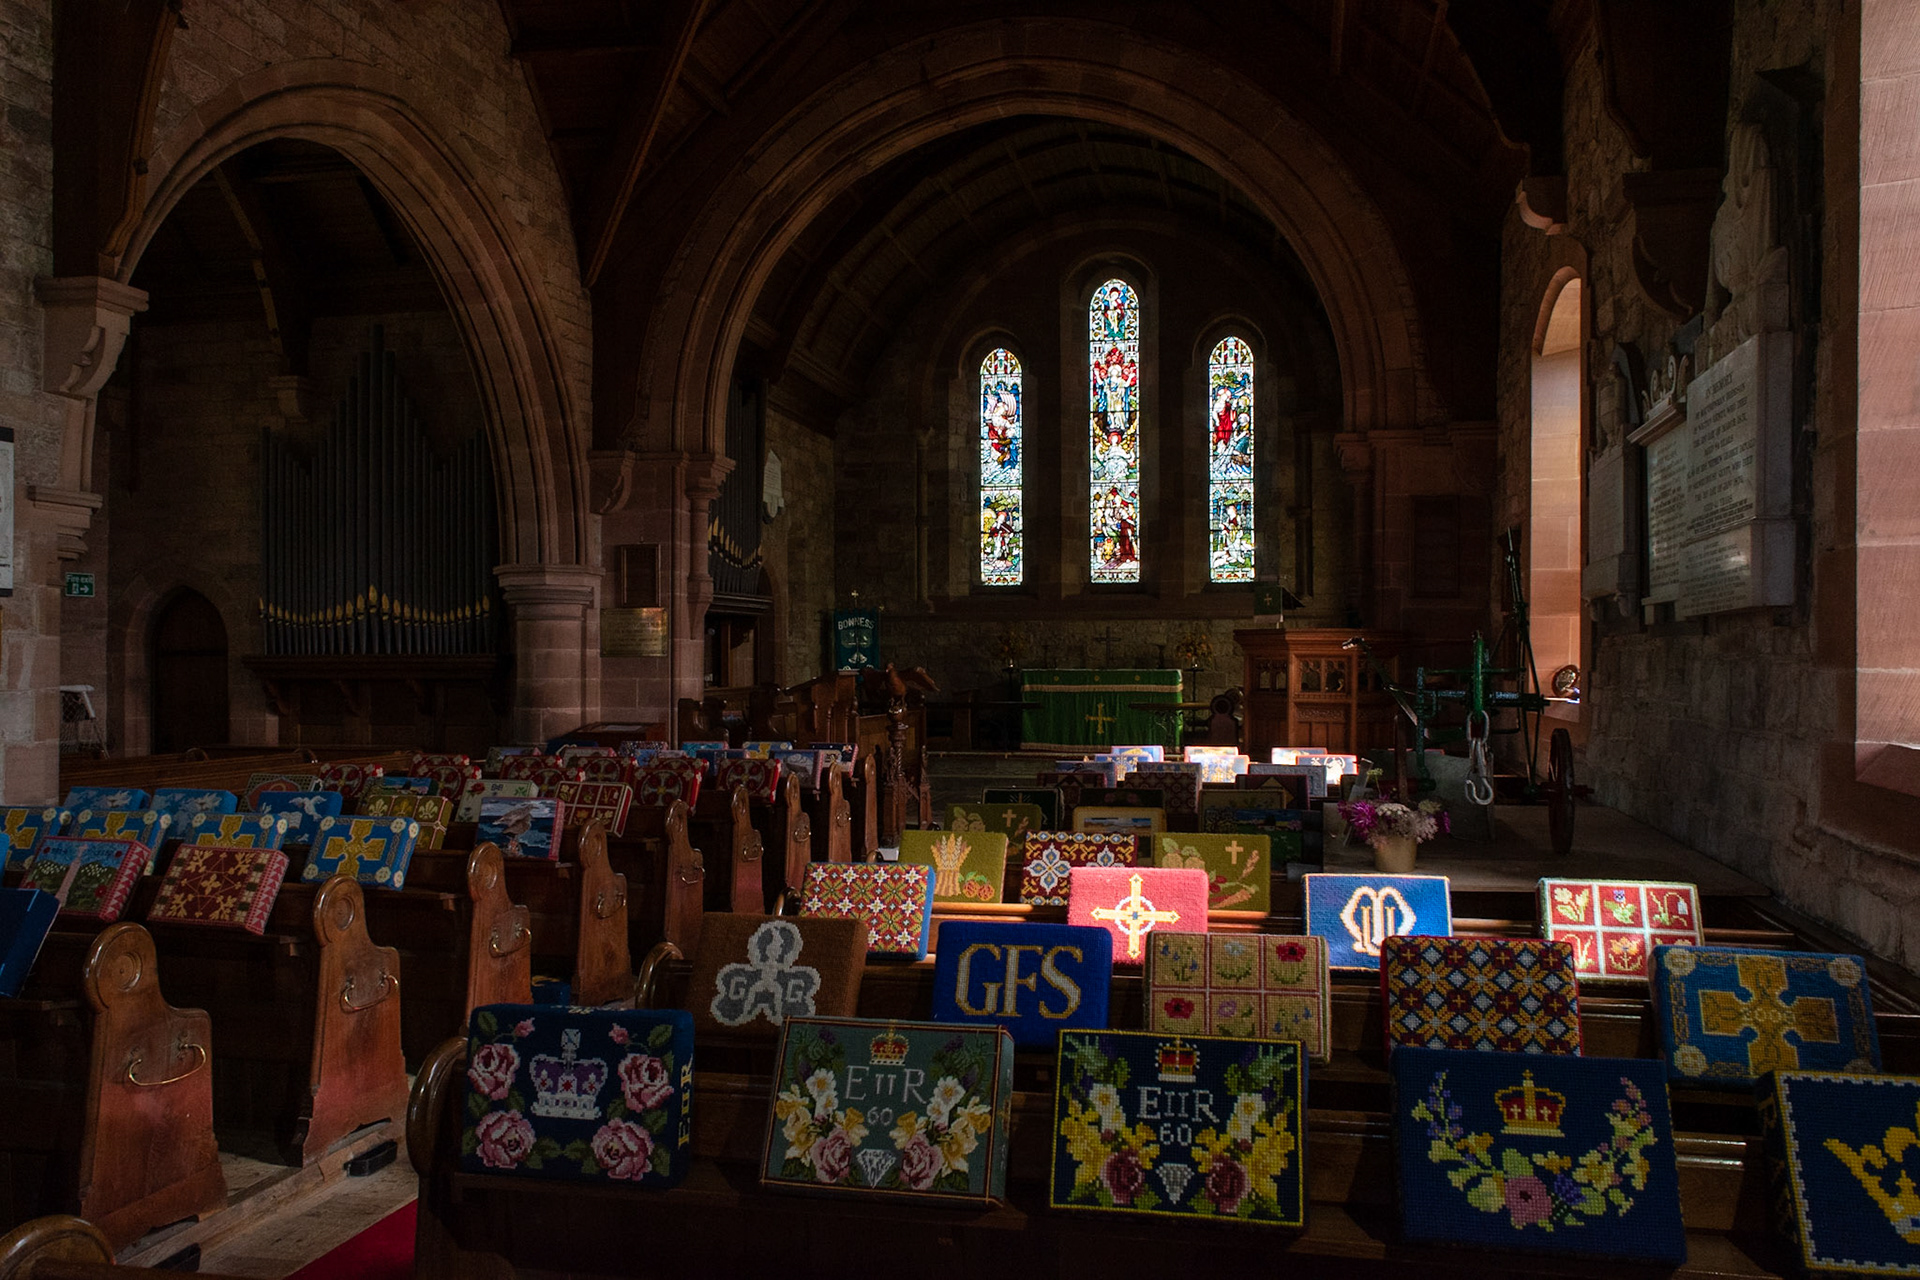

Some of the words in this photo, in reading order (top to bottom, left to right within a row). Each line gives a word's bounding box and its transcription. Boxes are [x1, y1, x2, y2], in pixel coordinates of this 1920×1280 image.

[67, 574, 79, 583] Fire
[81, 576, 93, 584] exit
[837, 616, 875, 630] BOWNESS
[728, 976, 747, 1000] G
[786, 979, 805, 1003] G
[955, 943, 1083, 1019] GFS
[867, 1106, 893, 1127] 60
[1159, 1122, 1192, 1146] 60
